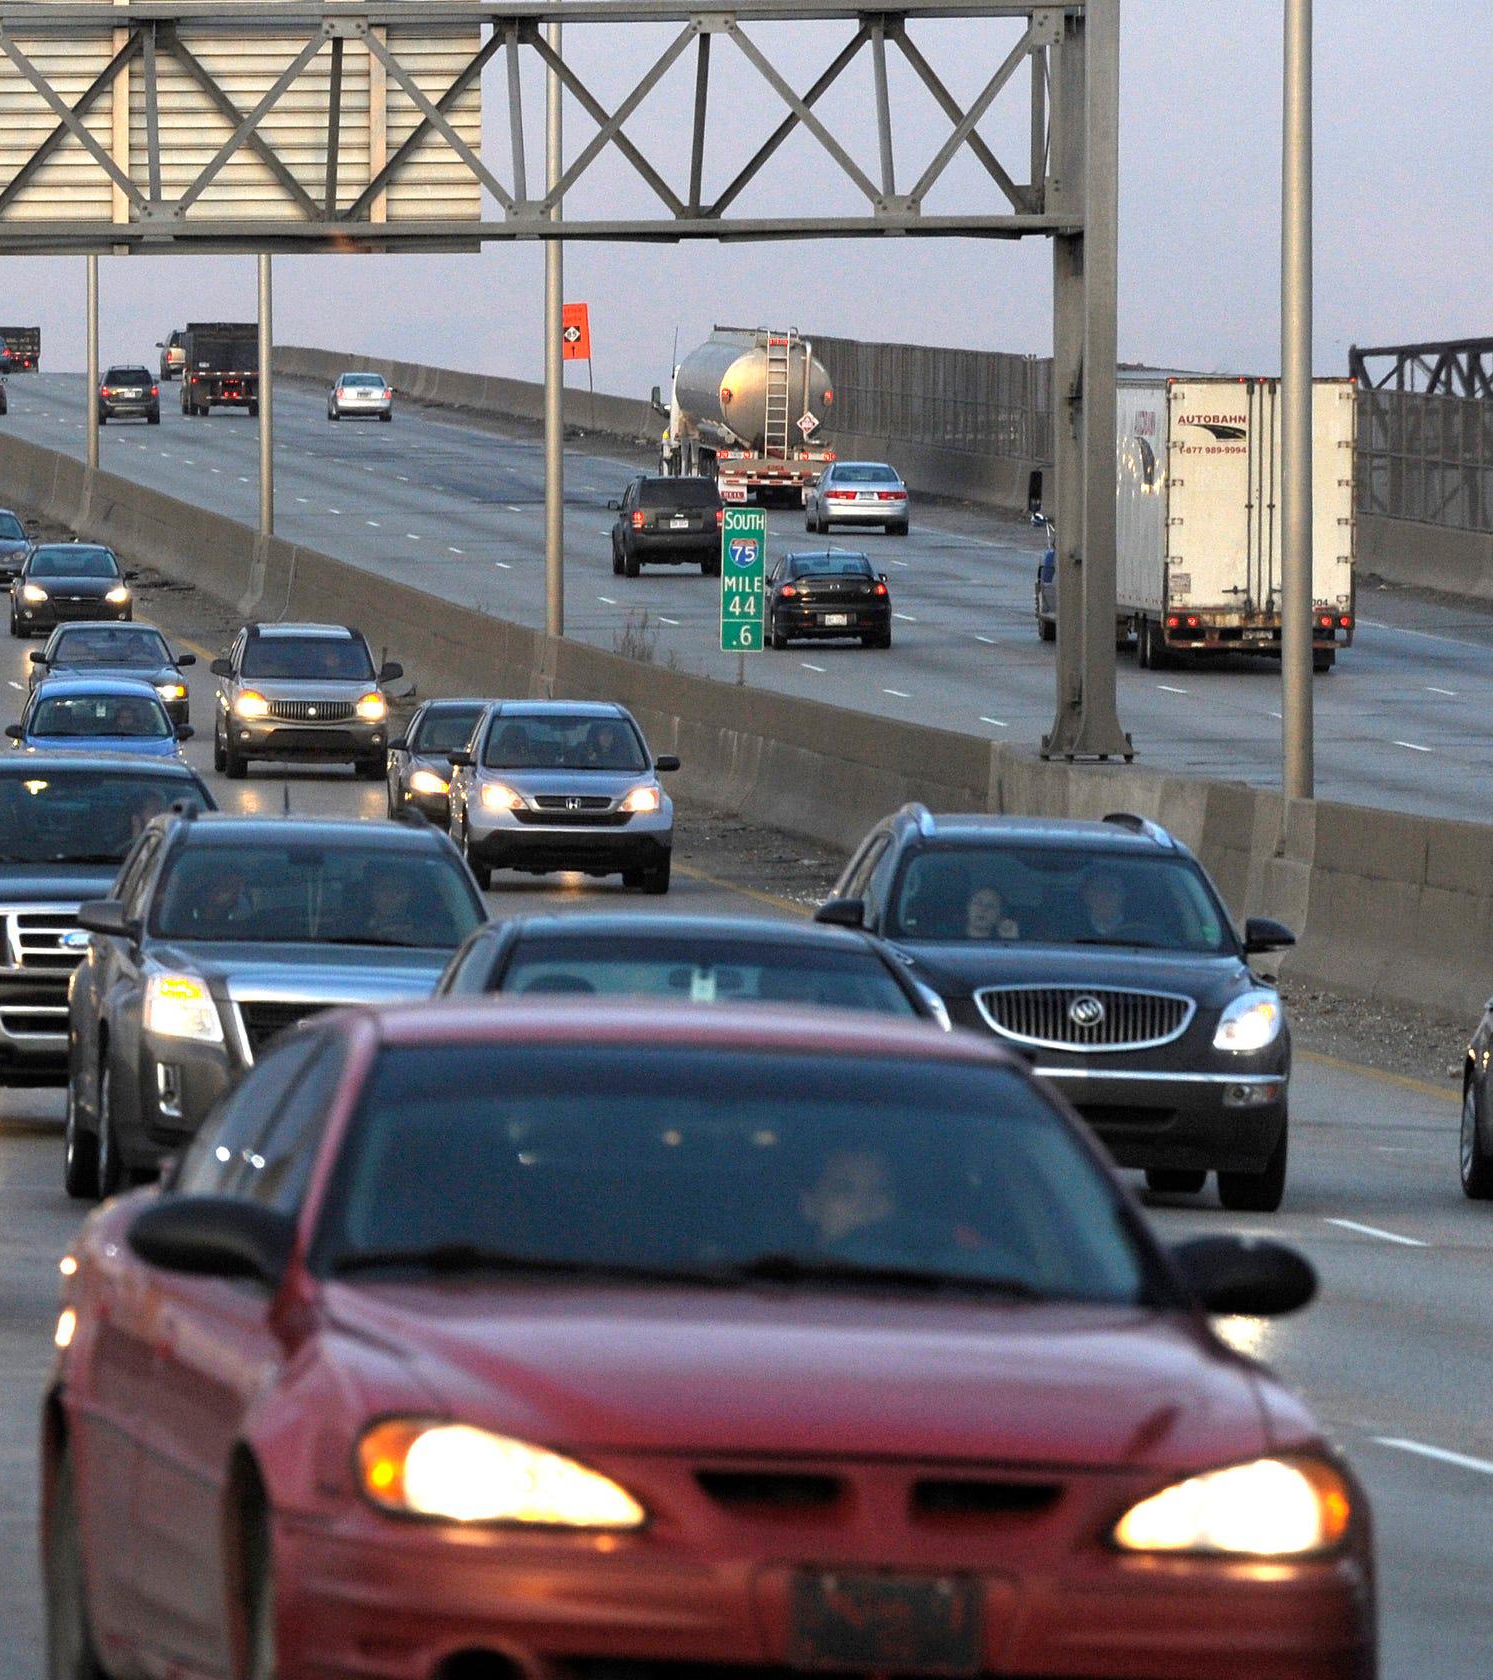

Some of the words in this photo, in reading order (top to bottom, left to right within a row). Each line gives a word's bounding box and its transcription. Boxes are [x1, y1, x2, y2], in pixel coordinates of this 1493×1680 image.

[1178, 415, 1246, 424] AUTOBAHN
[725, 512, 764, 530] SOUTH
[732, 546, 755, 562] 75
[725, 576, 762, 592] MILE
[729, 596, 755, 616] 44
[732, 625, 752, 646] .6
